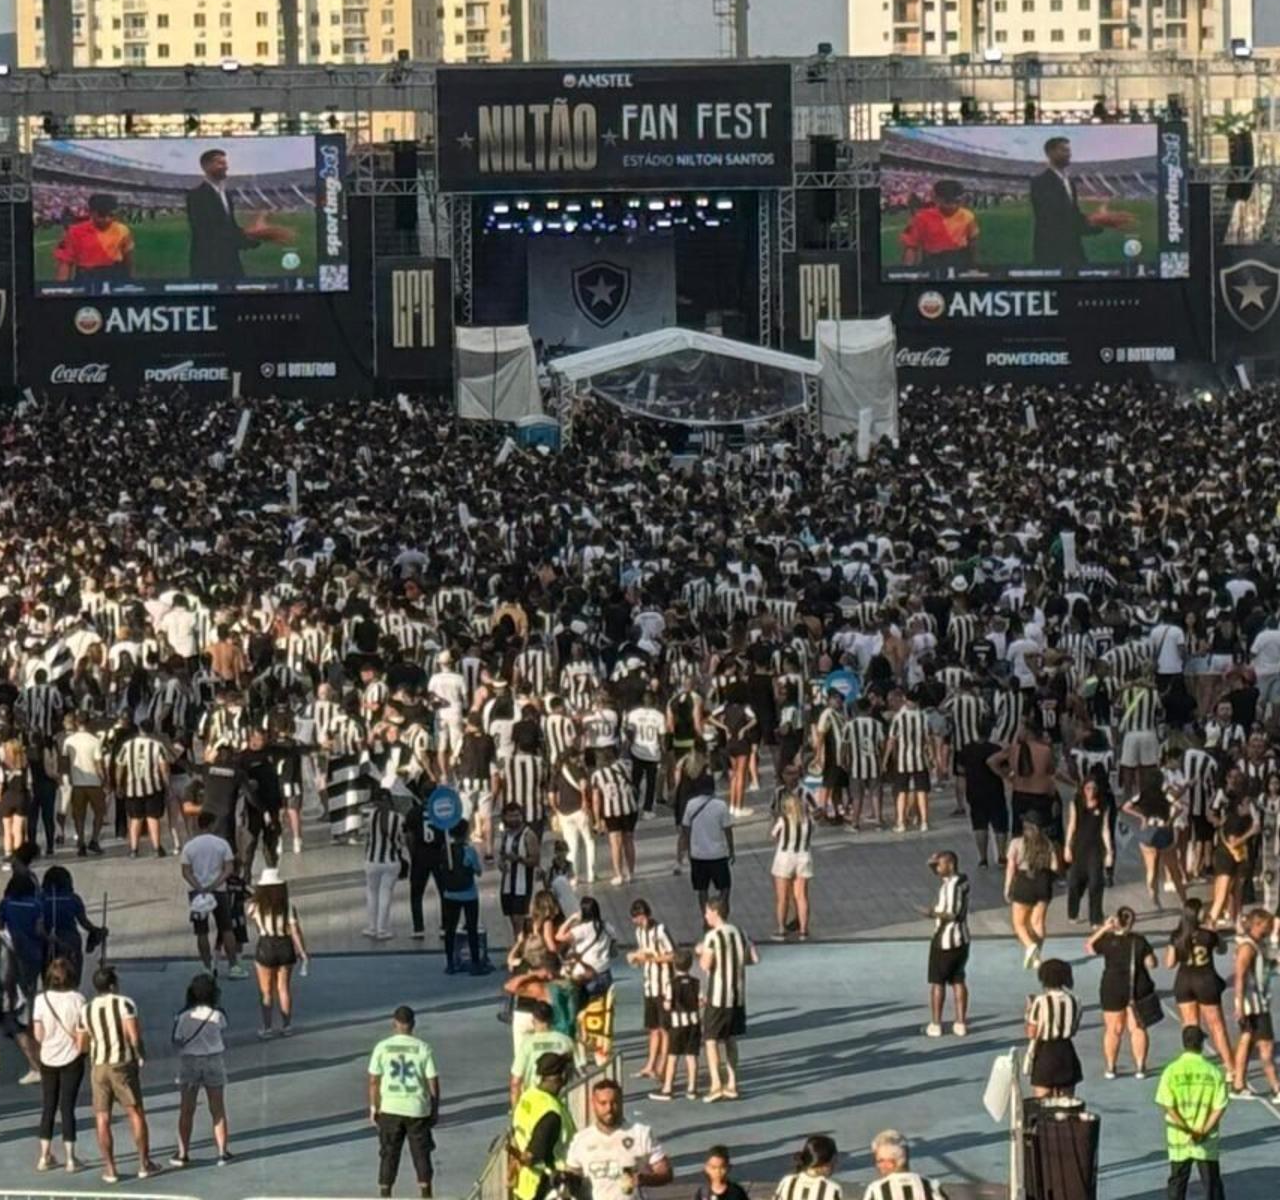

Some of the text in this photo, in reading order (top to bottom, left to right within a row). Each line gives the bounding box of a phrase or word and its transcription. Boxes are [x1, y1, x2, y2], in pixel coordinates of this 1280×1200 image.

[578, 73, 633, 88] AMSTEL
[622, 102, 773, 140] FAN FEST
[478, 99, 598, 172] NILTÃO
[623, 153, 775, 167] ESTÁDIO NILTON SANTOS
[947, 291, 1059, 317] AMSTEL
[105, 306, 218, 333] AMSTEL
[986, 352, 1070, 366] POWERADE
[578, 674, 587, 694] 7
